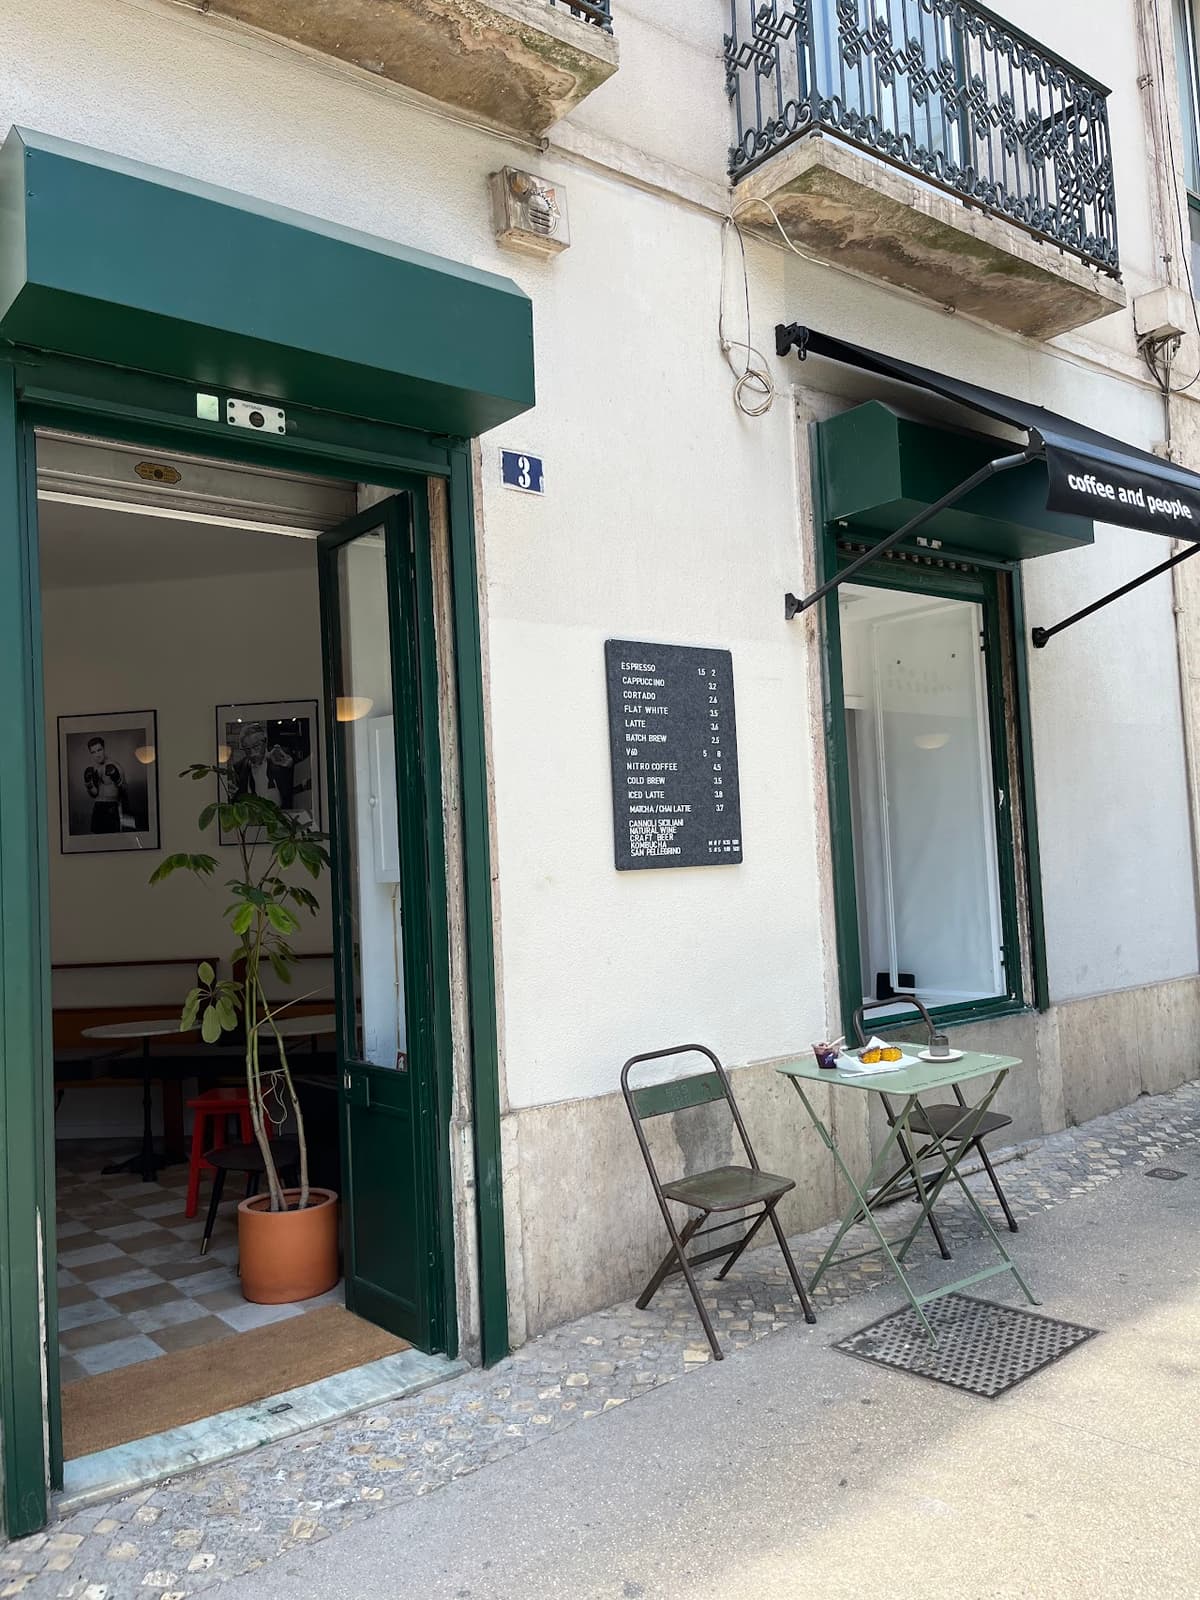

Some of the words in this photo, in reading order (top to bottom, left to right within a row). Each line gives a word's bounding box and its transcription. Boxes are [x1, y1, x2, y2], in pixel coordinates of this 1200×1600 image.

[518, 456, 531, 488] 3
[1068, 474, 1115, 500] coffee
[1118, 488, 1145, 507] and
[1147, 495, 1192, 519] people
[621, 662, 656, 672] ESPRESSO
[622, 677, 665, 687] CAPPUCCINO
[623, 691, 656, 700] CORTADO
[645, 706, 669, 714] WHITE
[625, 720, 646, 728] LATTE
[626, 734, 646, 742] BATCH
[648, 735, 667, 743] BREW
[652, 763, 678, 771] COFFEE
[629, 791, 642, 799] ICED
[646, 791, 664, 799] LATTE
[630, 805, 654, 813] MATCHA
[630, 826, 658, 834] NATURAL
[630, 834, 652, 842] CRAFT
